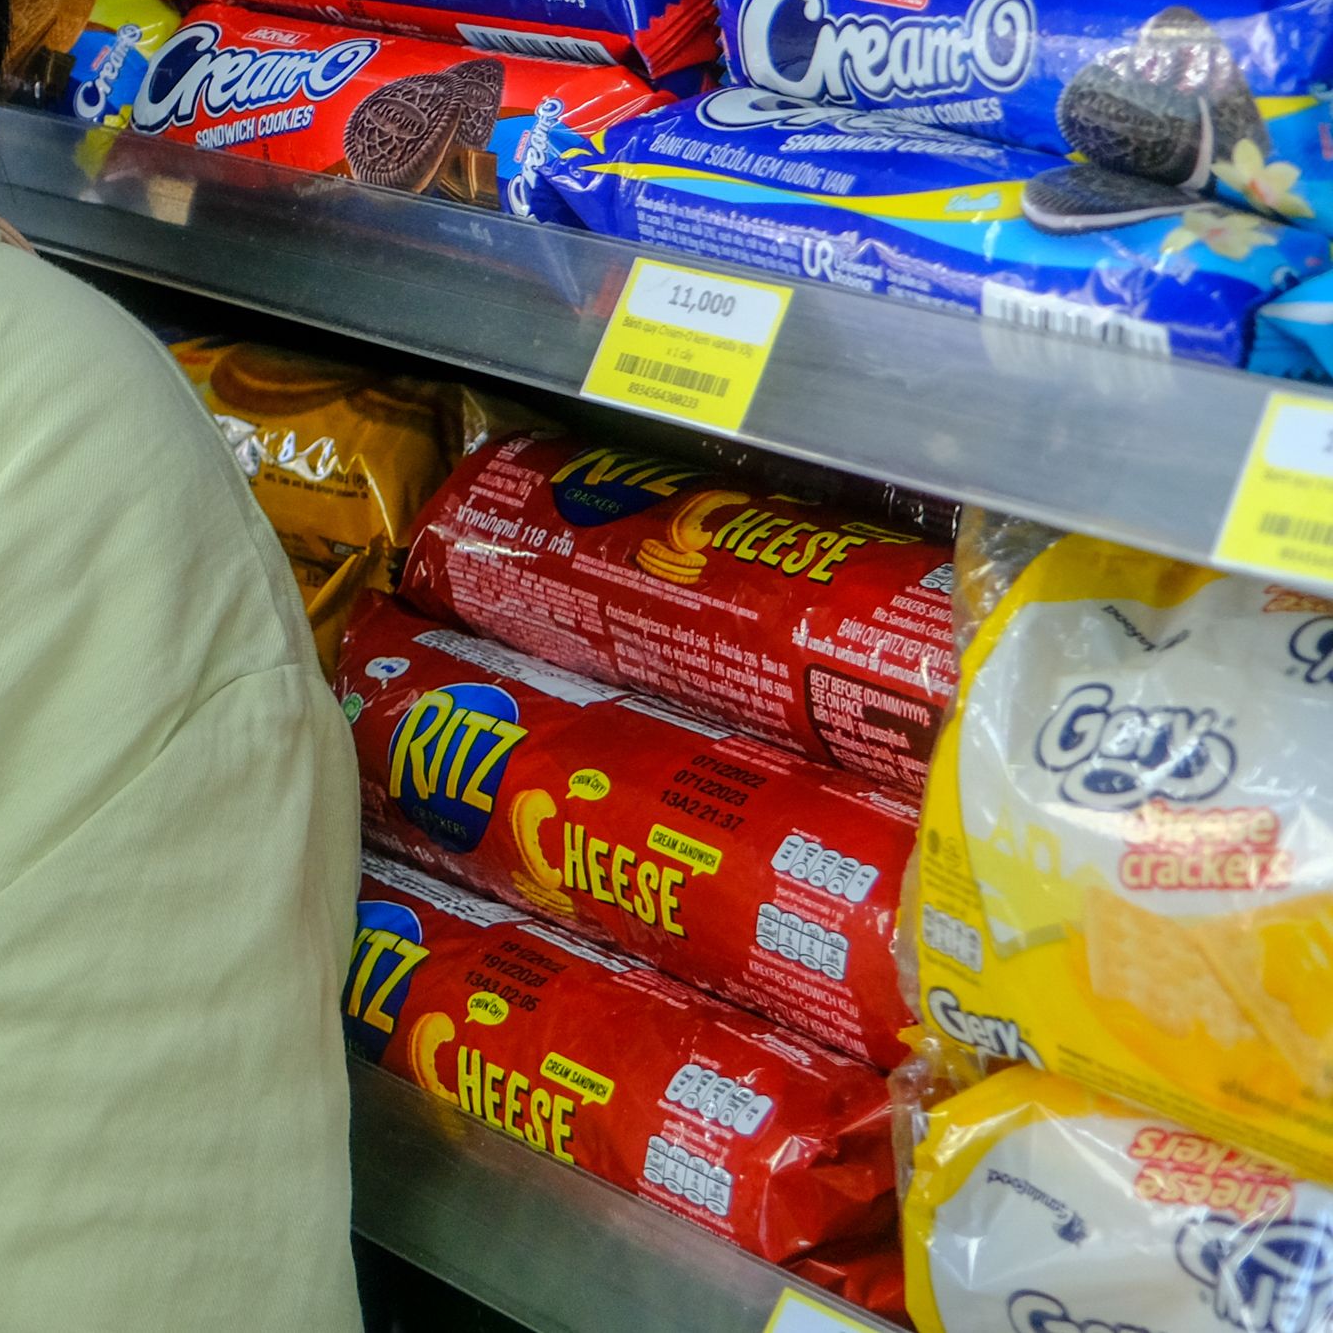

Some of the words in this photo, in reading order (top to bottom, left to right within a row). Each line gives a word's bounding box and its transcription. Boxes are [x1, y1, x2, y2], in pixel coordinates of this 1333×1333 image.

[195, 121, 257, 150] SANDWICH
[257, 104, 314, 138] COOKIES
[933, 96, 1002, 125] COOKIES
[779, 132, 897, 154] SANDWICH
[649, 132, 684, 158] BÁNH
[683, 140, 710, 163] QUY
[749, 155, 779, 180] KEM
[823, 172, 858, 196] VANI
[668, 284, 737, 317] 11,000
[564, 486, 623, 515] CRACKERS
[520, 525, 546, 549] 118
[810, 669, 831, 690] BEST
[830, 676, 863, 700] BEFORE
[810, 687, 826, 705] SEE
[826, 693, 840, 710] ON
[839, 697, 865, 720] PACK
[389, 689, 530, 814] RITZ
[673, 769, 750, 808] 07122023
[651, 830, 679, 853] CREAM
[677, 840, 719, 868] SANDWICH
[348, 928, 431, 1035] ITZ
[544, 1058, 572, 1082] CREAM
[569, 1067, 609, 1099] SANDWICH
